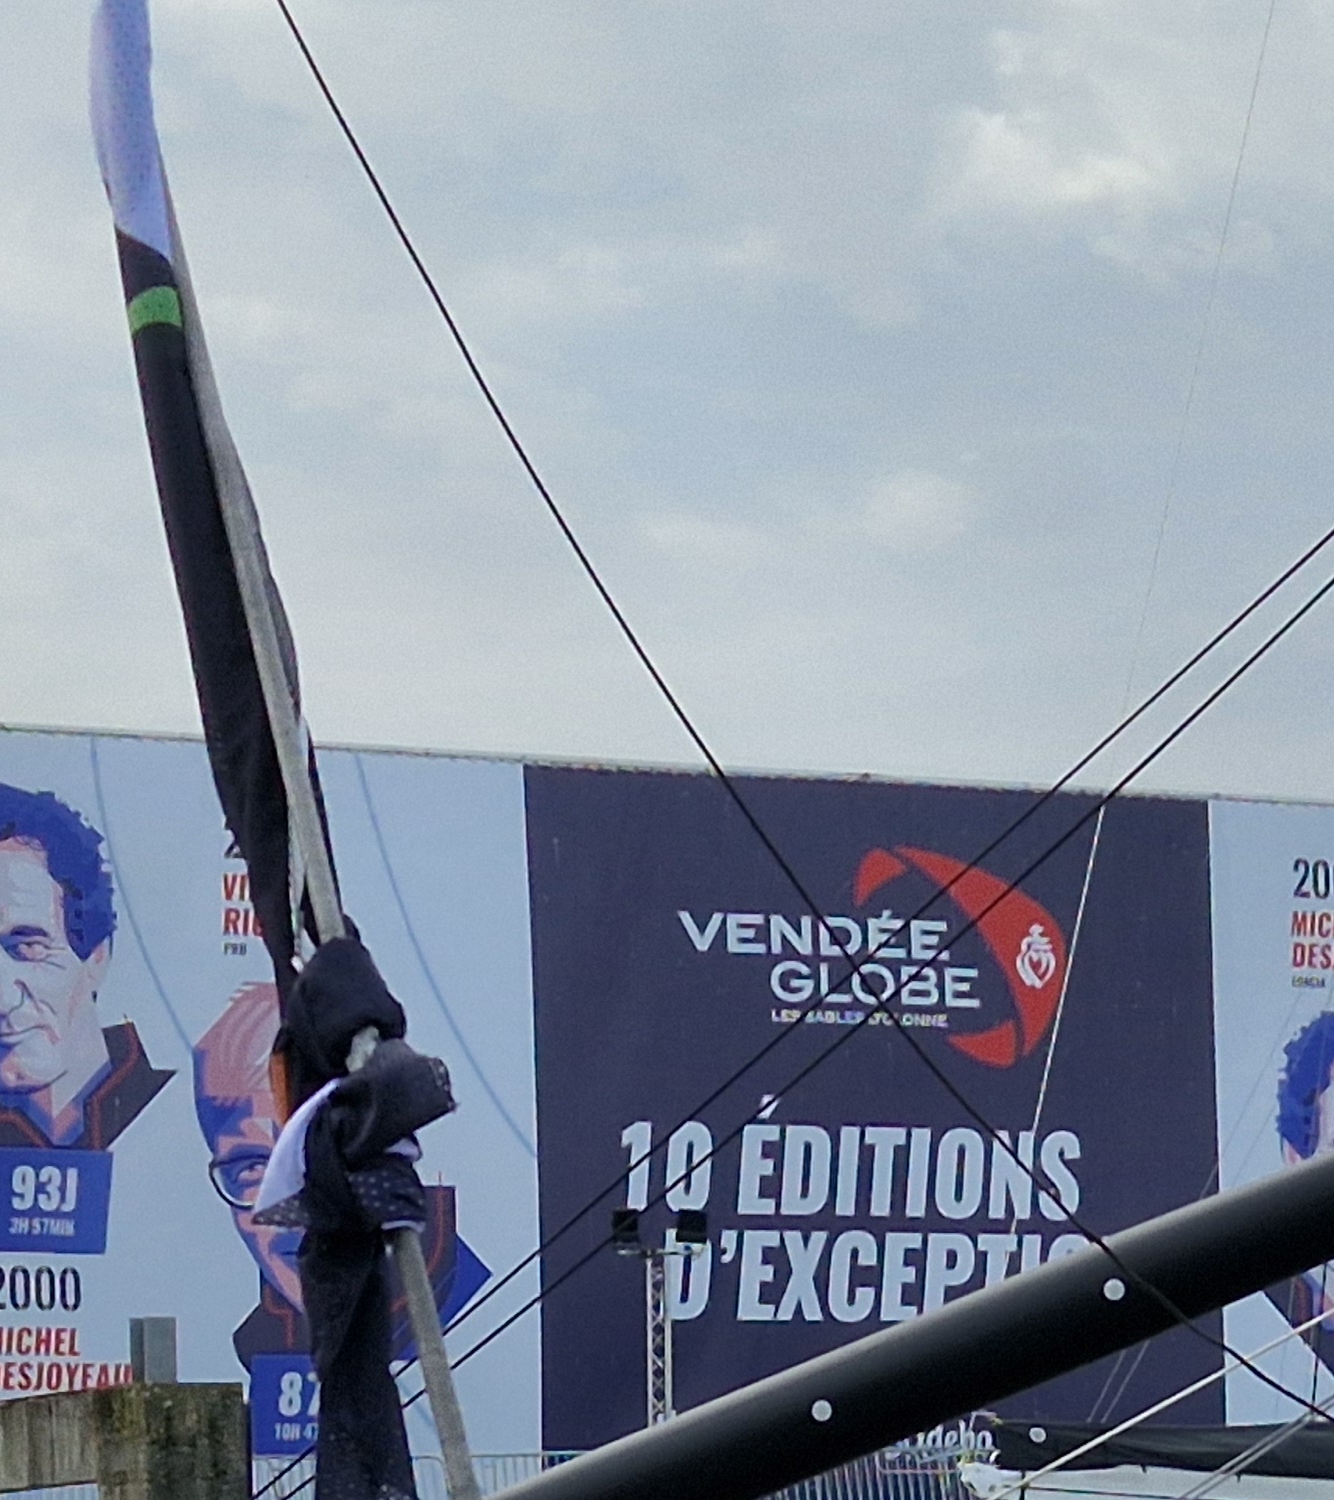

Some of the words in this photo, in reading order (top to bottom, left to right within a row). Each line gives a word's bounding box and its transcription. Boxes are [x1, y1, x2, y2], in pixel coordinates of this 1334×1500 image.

[677, 908, 951, 961] VENDÉE
[770, 960, 981, 1007] GLOBE
[620, 1120, 714, 1212] 10
[737, 1093, 1082, 1222] ÉDITIONS
[11, 1165, 79, 1213] 93J
